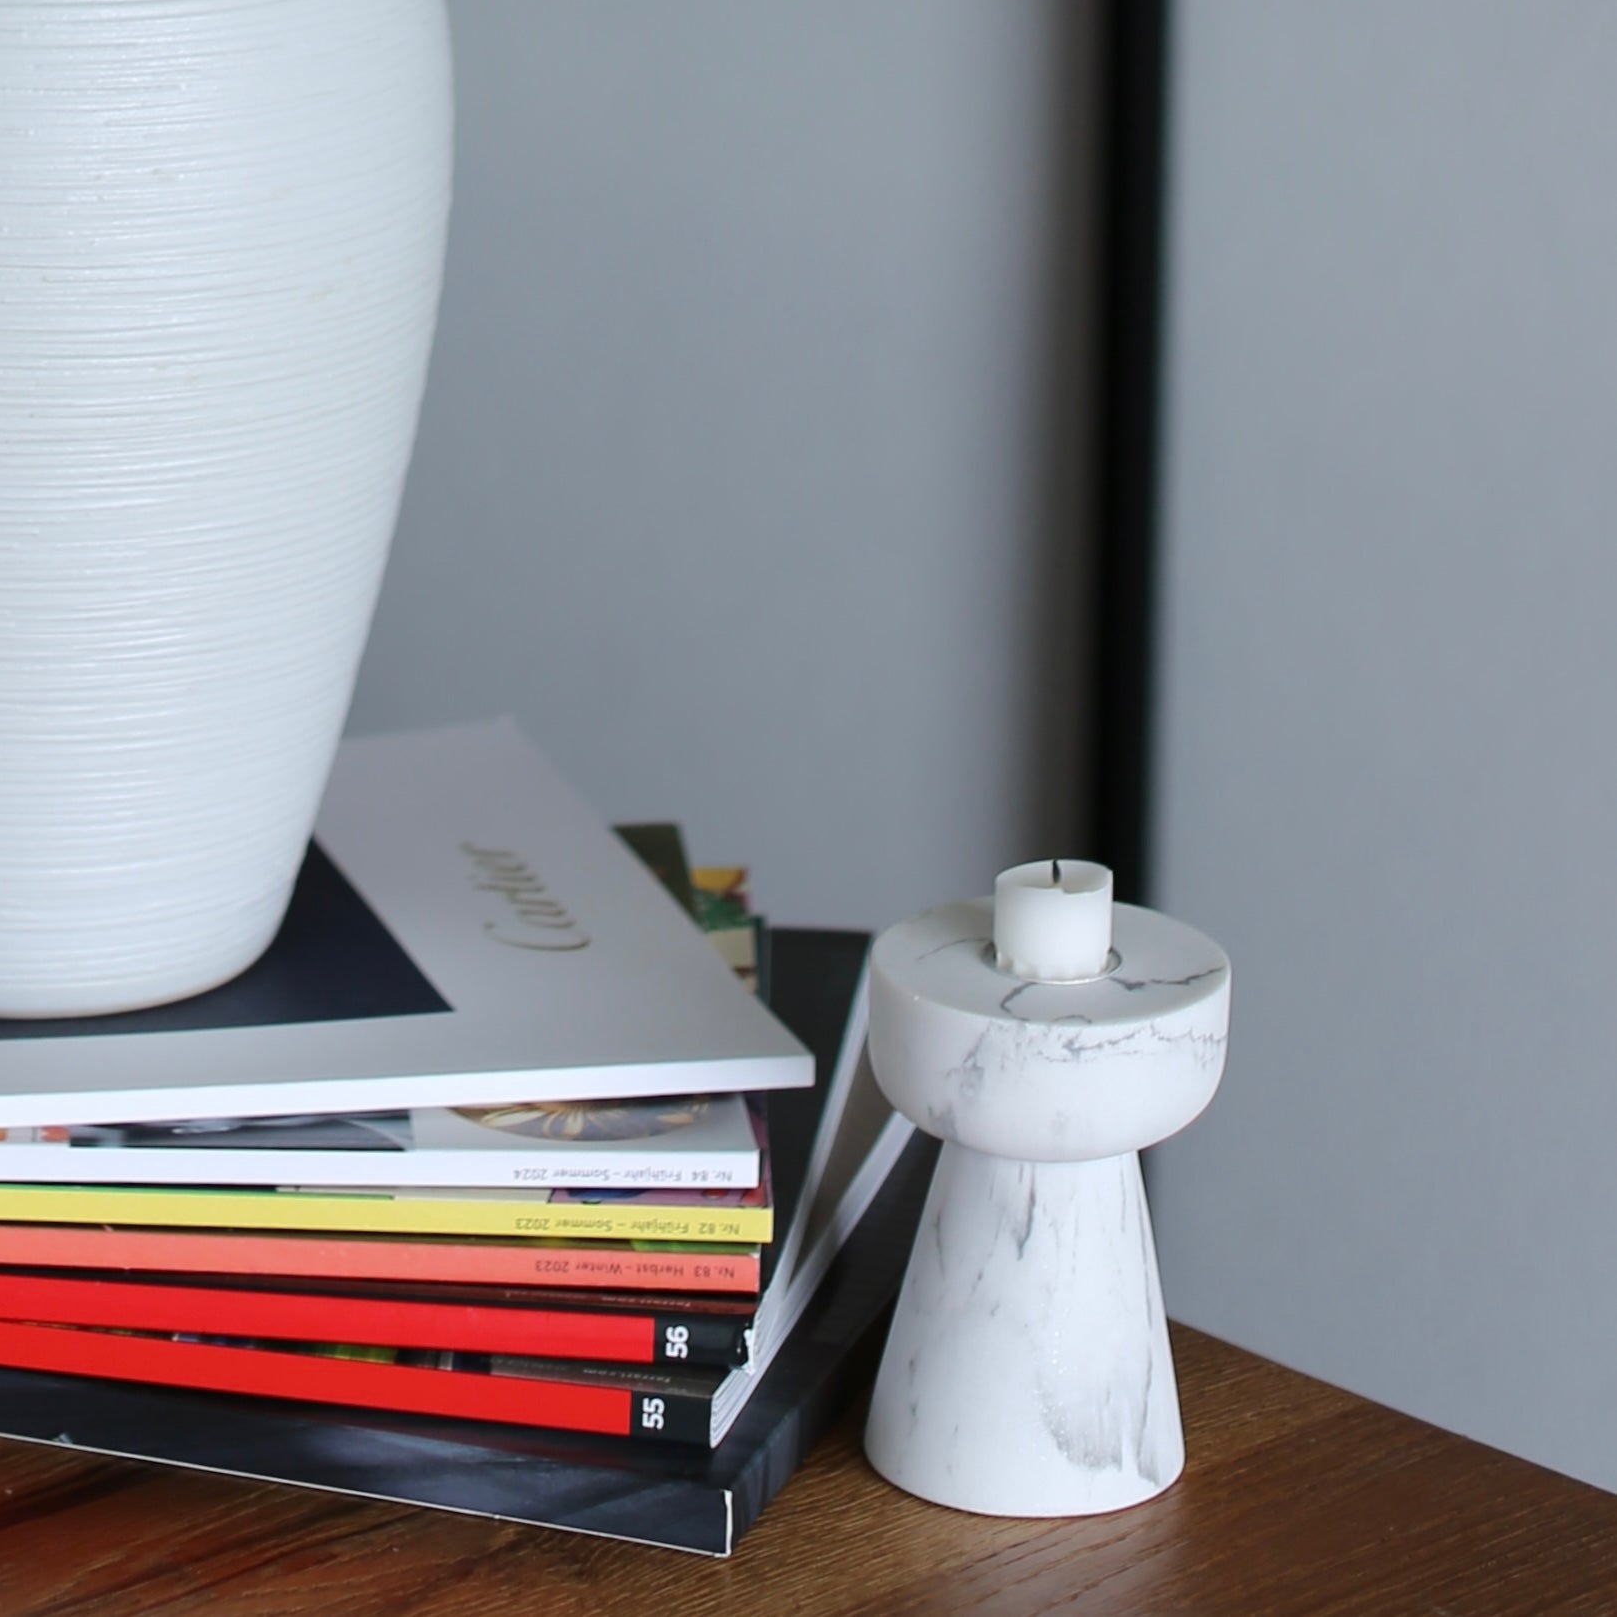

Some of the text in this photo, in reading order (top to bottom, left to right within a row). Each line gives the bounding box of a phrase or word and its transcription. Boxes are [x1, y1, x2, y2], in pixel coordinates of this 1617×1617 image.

[512, 1168, 549, 1180] 2024
[553, 1169, 610, 1180] Sommer
[692, 1170, 709, 1181] 84
[713, 1171, 733, 1182] Nr.
[515, 1218, 551, 1229] 2023
[555, 1219, 613, 1231] Sommer
[699, 1222, 716, 1234] 82
[719, 1223, 740, 1235] Nr.
[535, 1260, 569, 1272] 2023
[575, 1262, 622, 1274] Winter
[635, 1263, 684, 1275] Herbst
[694, 1266, 711, 1277] 83
[714, 1266, 735, 1277] Nr.
[665, 1325, 689, 1359] 56
[642, 1397, 665, 1431] 55
